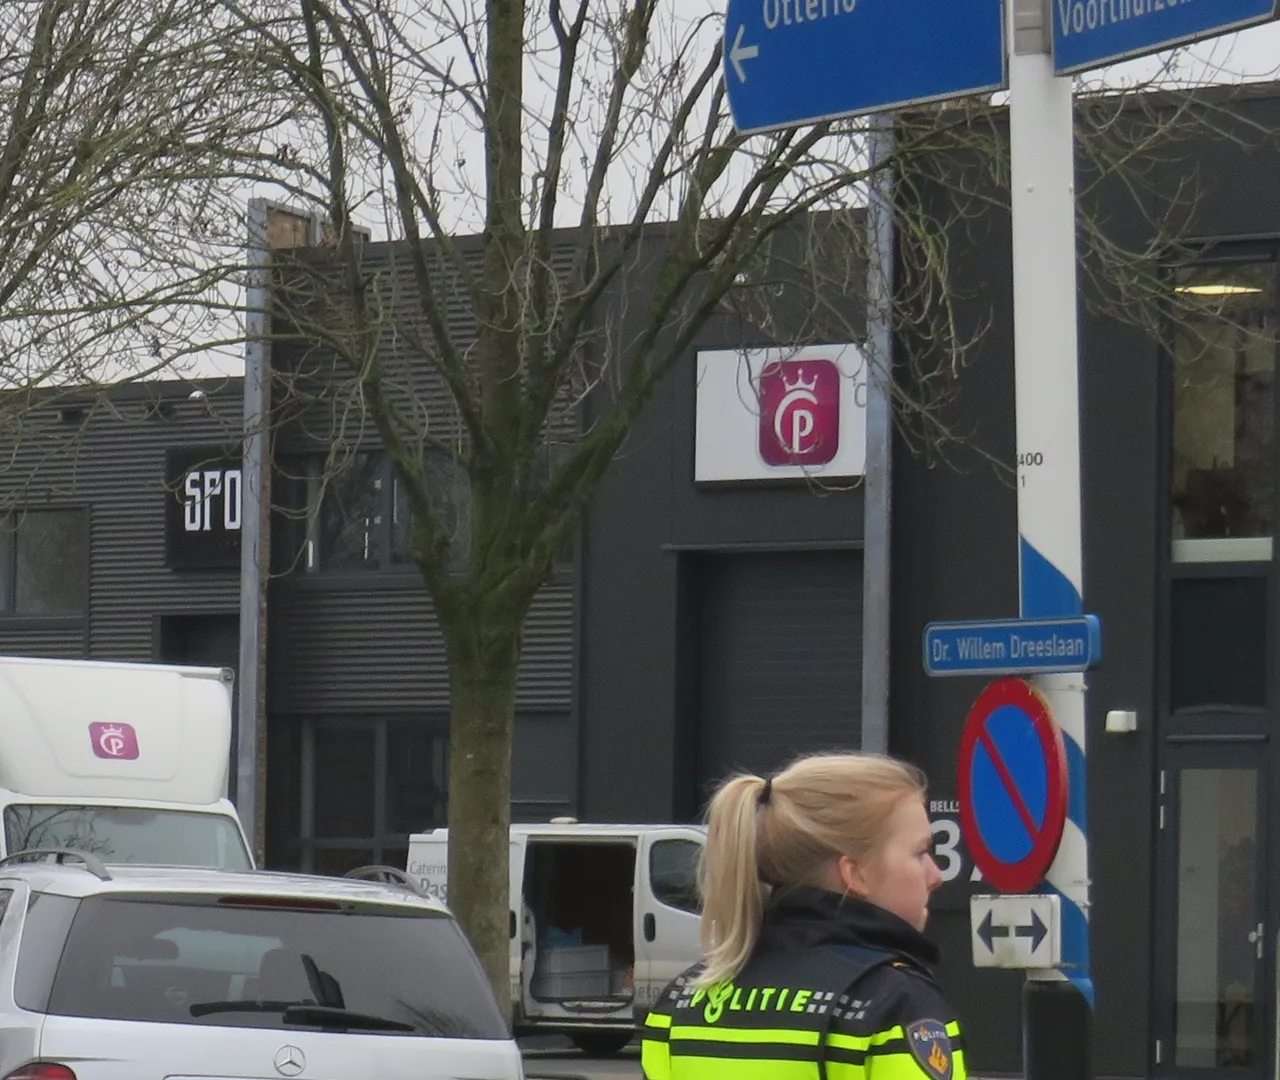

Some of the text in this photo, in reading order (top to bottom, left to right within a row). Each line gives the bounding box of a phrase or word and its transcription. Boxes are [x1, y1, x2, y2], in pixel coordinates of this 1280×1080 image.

[933, 633, 1086, 662] Dr. Willem Dreeslaan
[409, 861, 447, 875] Caterin
[690, 984, 813, 1023] POLITIE
